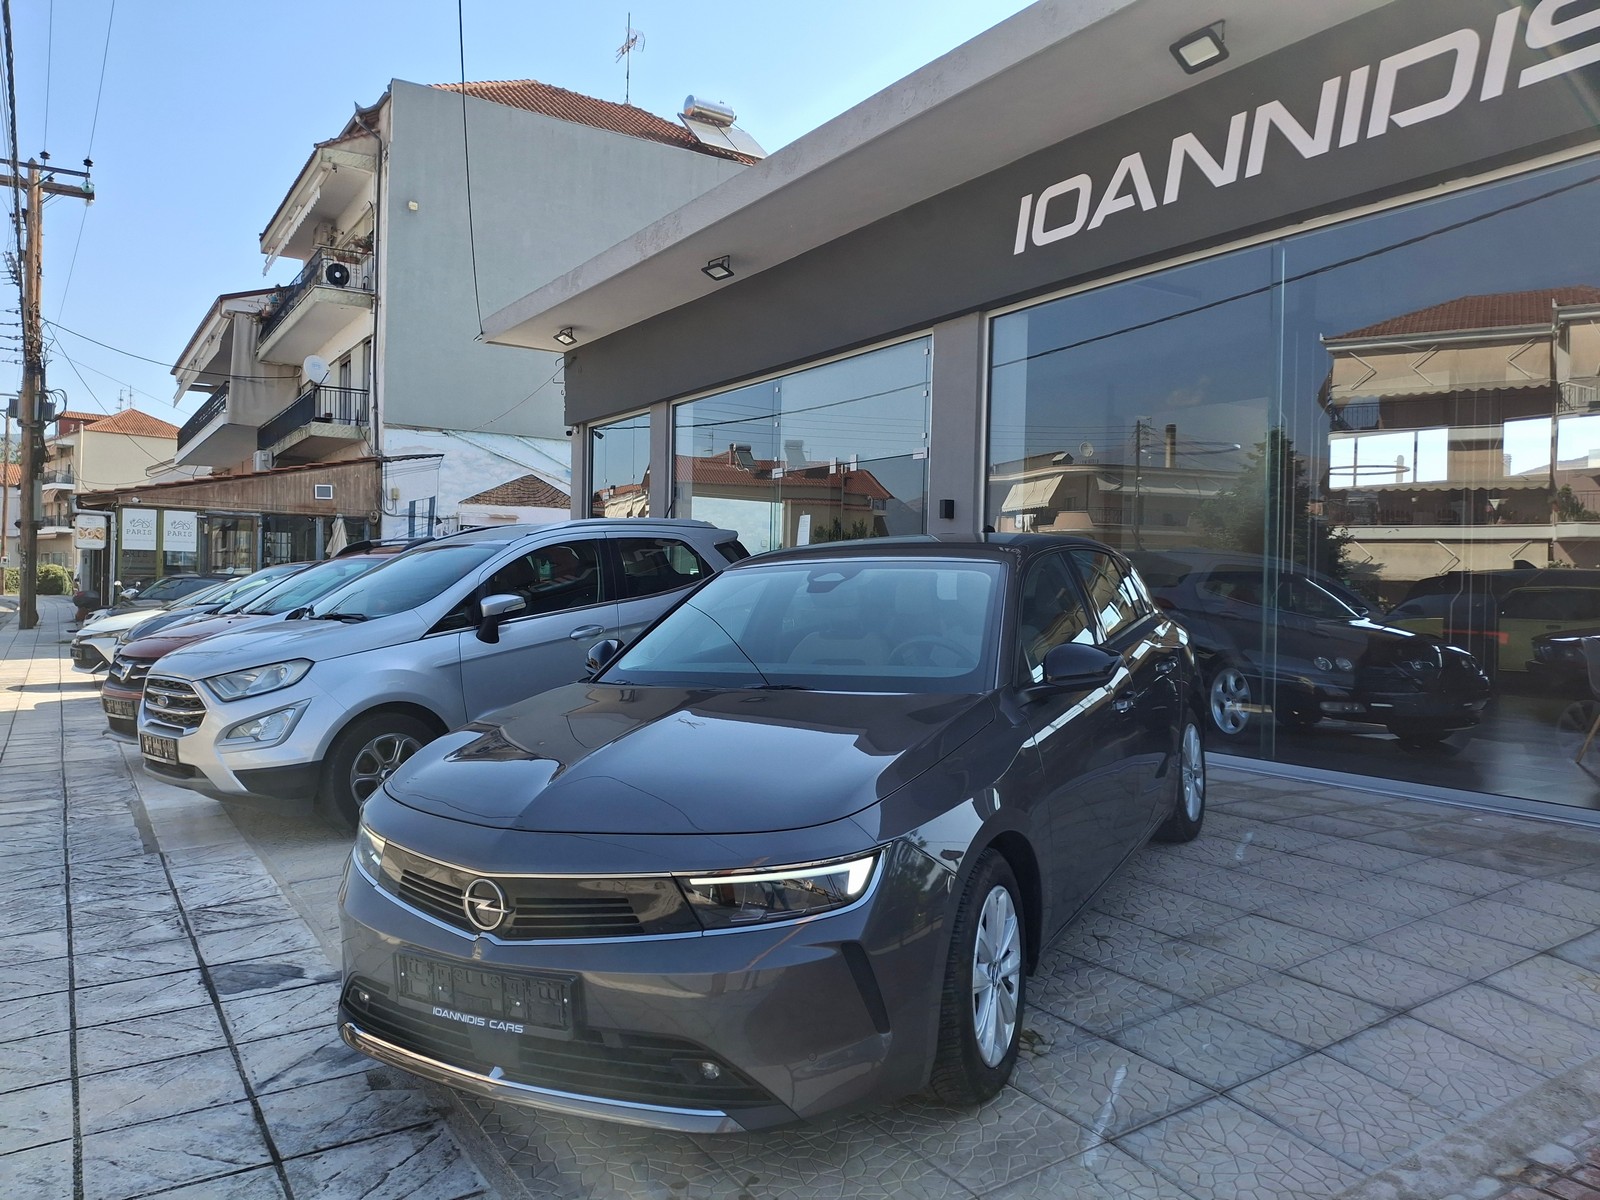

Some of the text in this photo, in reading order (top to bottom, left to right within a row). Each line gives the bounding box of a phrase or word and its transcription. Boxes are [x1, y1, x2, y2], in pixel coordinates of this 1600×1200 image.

[1013, 0, 1600, 256] IOANNIDIS
[126, 528, 152, 536] PARIS
[432, 1006, 524, 1034] IOANNIDIS CARS
